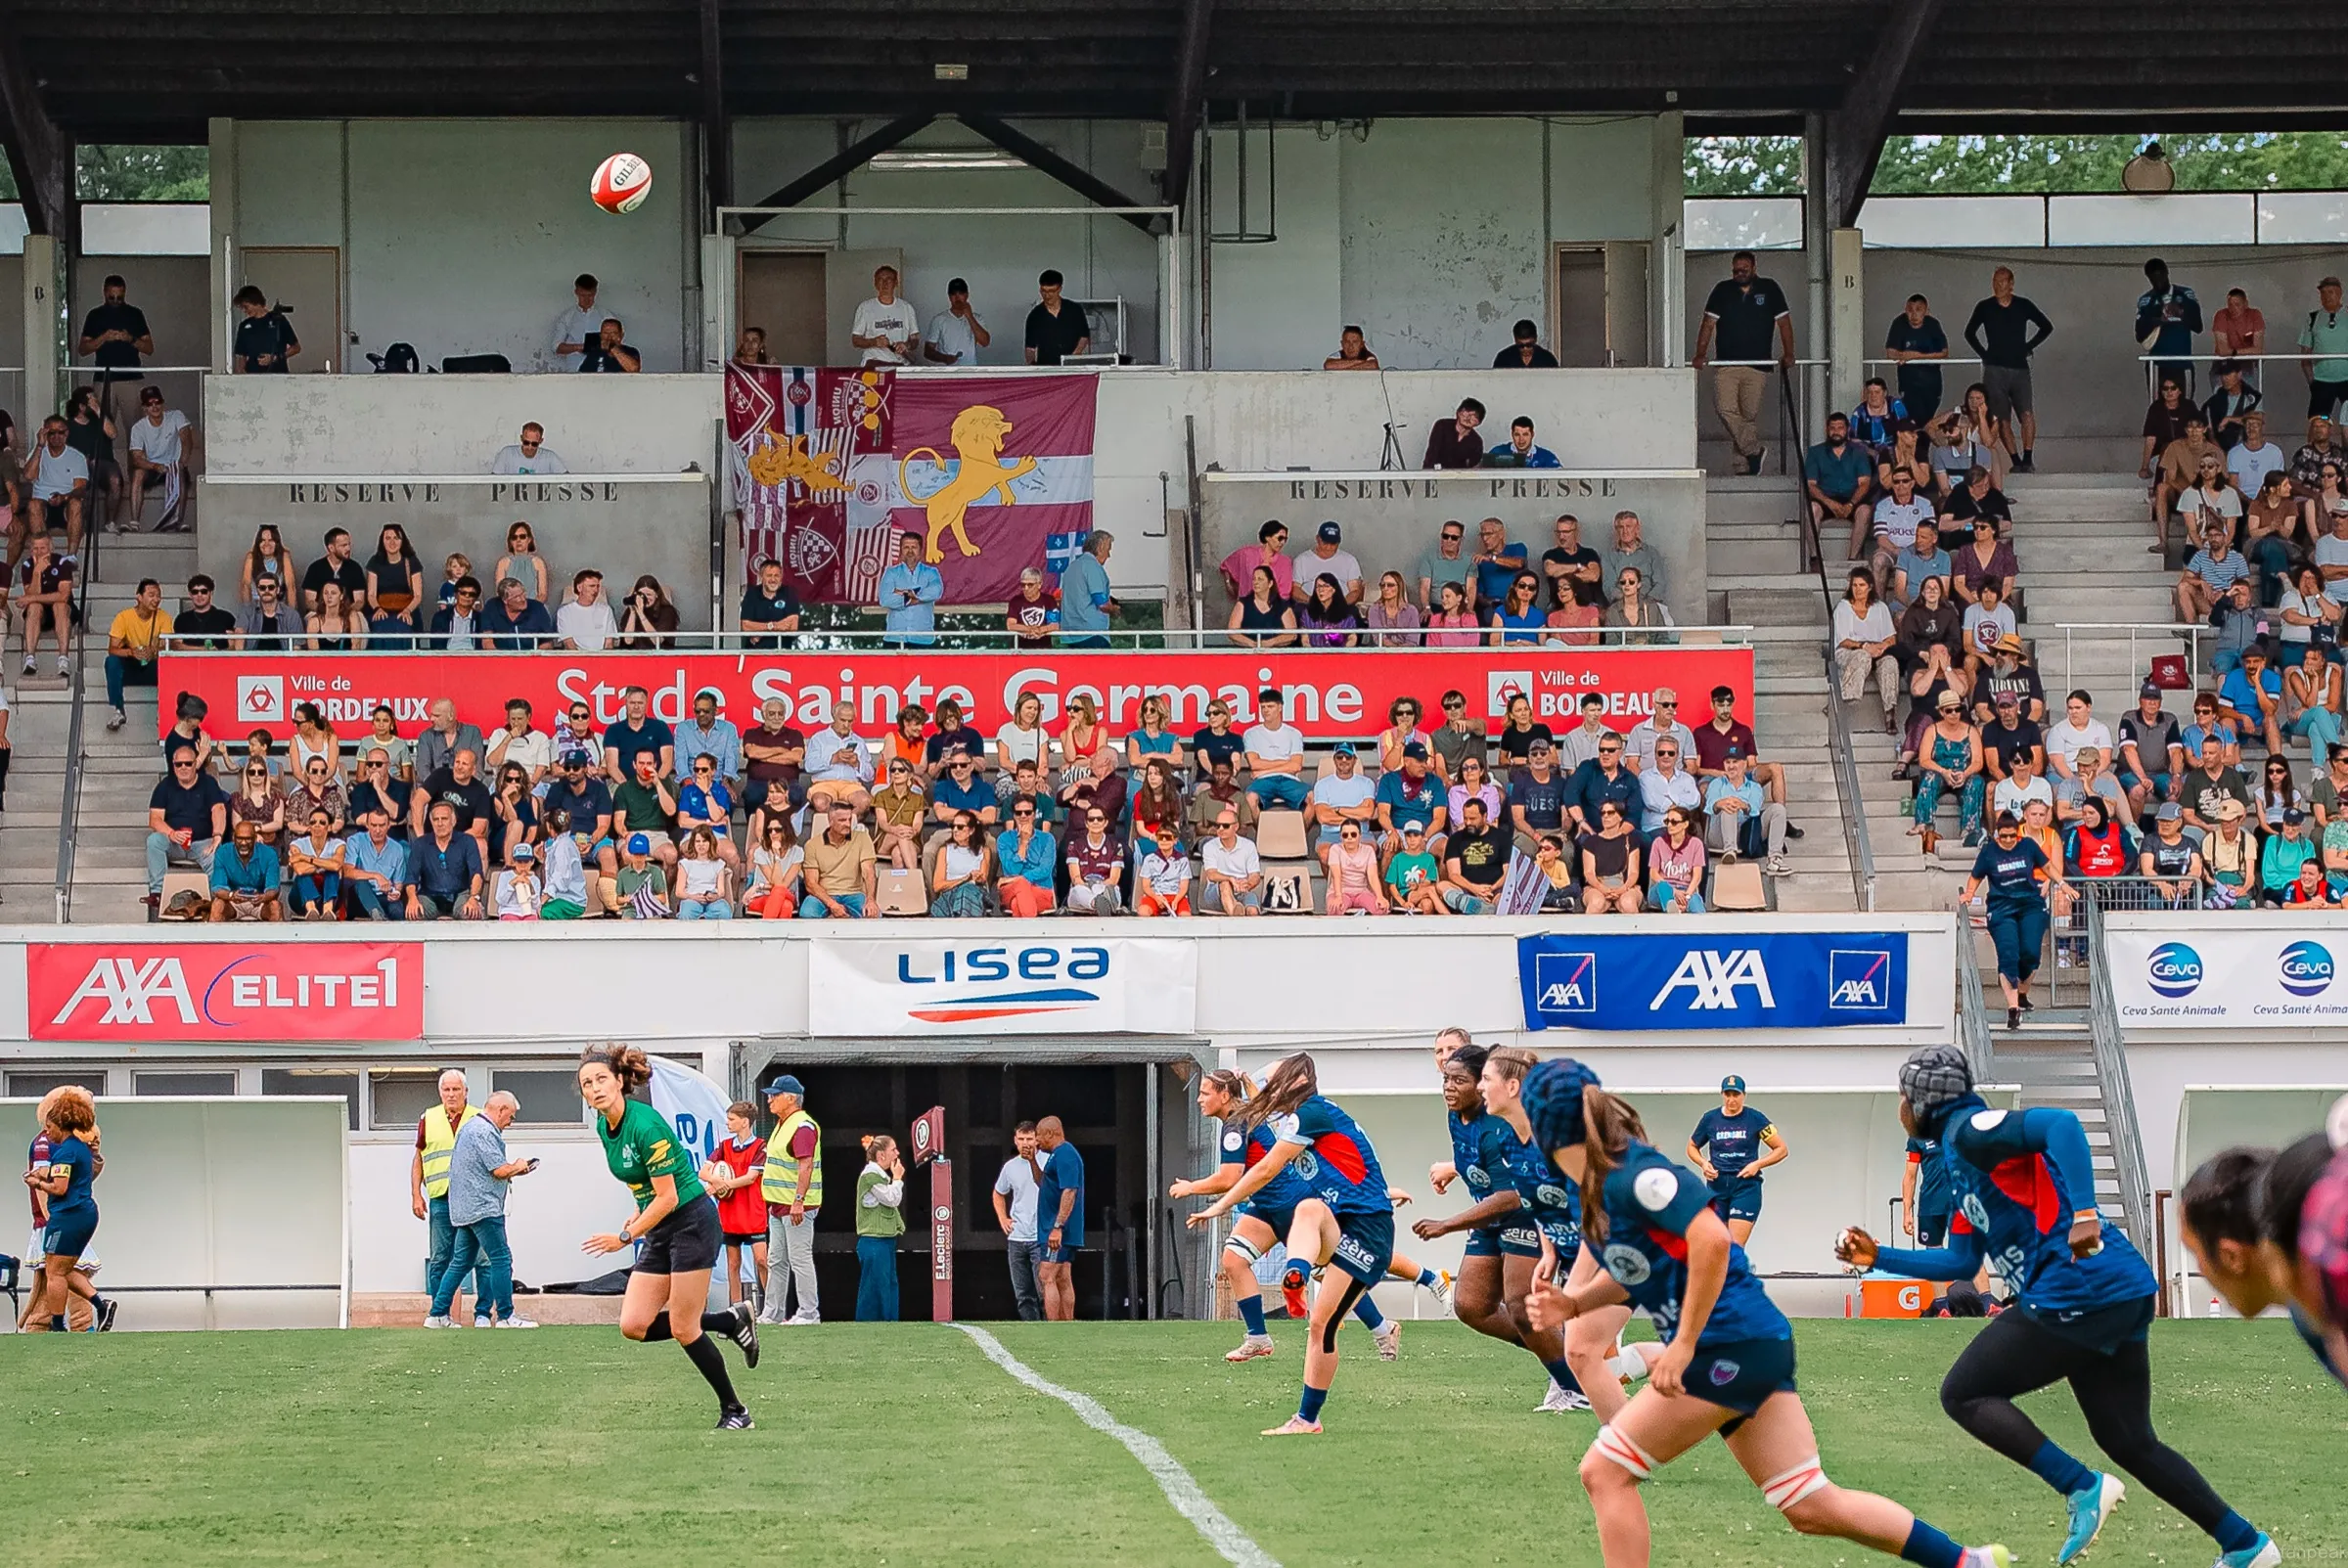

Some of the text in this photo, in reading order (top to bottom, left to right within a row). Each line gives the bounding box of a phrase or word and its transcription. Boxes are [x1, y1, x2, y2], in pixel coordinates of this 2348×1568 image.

[614, 157, 643, 187] GILBE
[1844, 274, 1855, 290] B
[33, 286, 45, 301] B
[491, 483, 618, 503] PRESSE
[1490, 478, 1617, 498] PRESSE
[291, 675, 351, 691] Ville de
[1540, 670, 1600, 686] Ville de
[1540, 693, 1677, 716] BODEAU
[1649, 949, 1776, 1010] AXA
[51, 958, 397, 1024] AXA ELITE1
[1538, 983, 1585, 1006] AXA
[1830, 979, 1877, 1003] AXA
[2122, 1005, 2227, 1015] Ceva Santé Animale
[2253, 1005, 2280, 1015] Ceva
[2281, 1004, 2312, 1014] Santé
[935, 1224, 945, 1279] E.Leclerc
[1898, 1285, 1919, 1312] G
